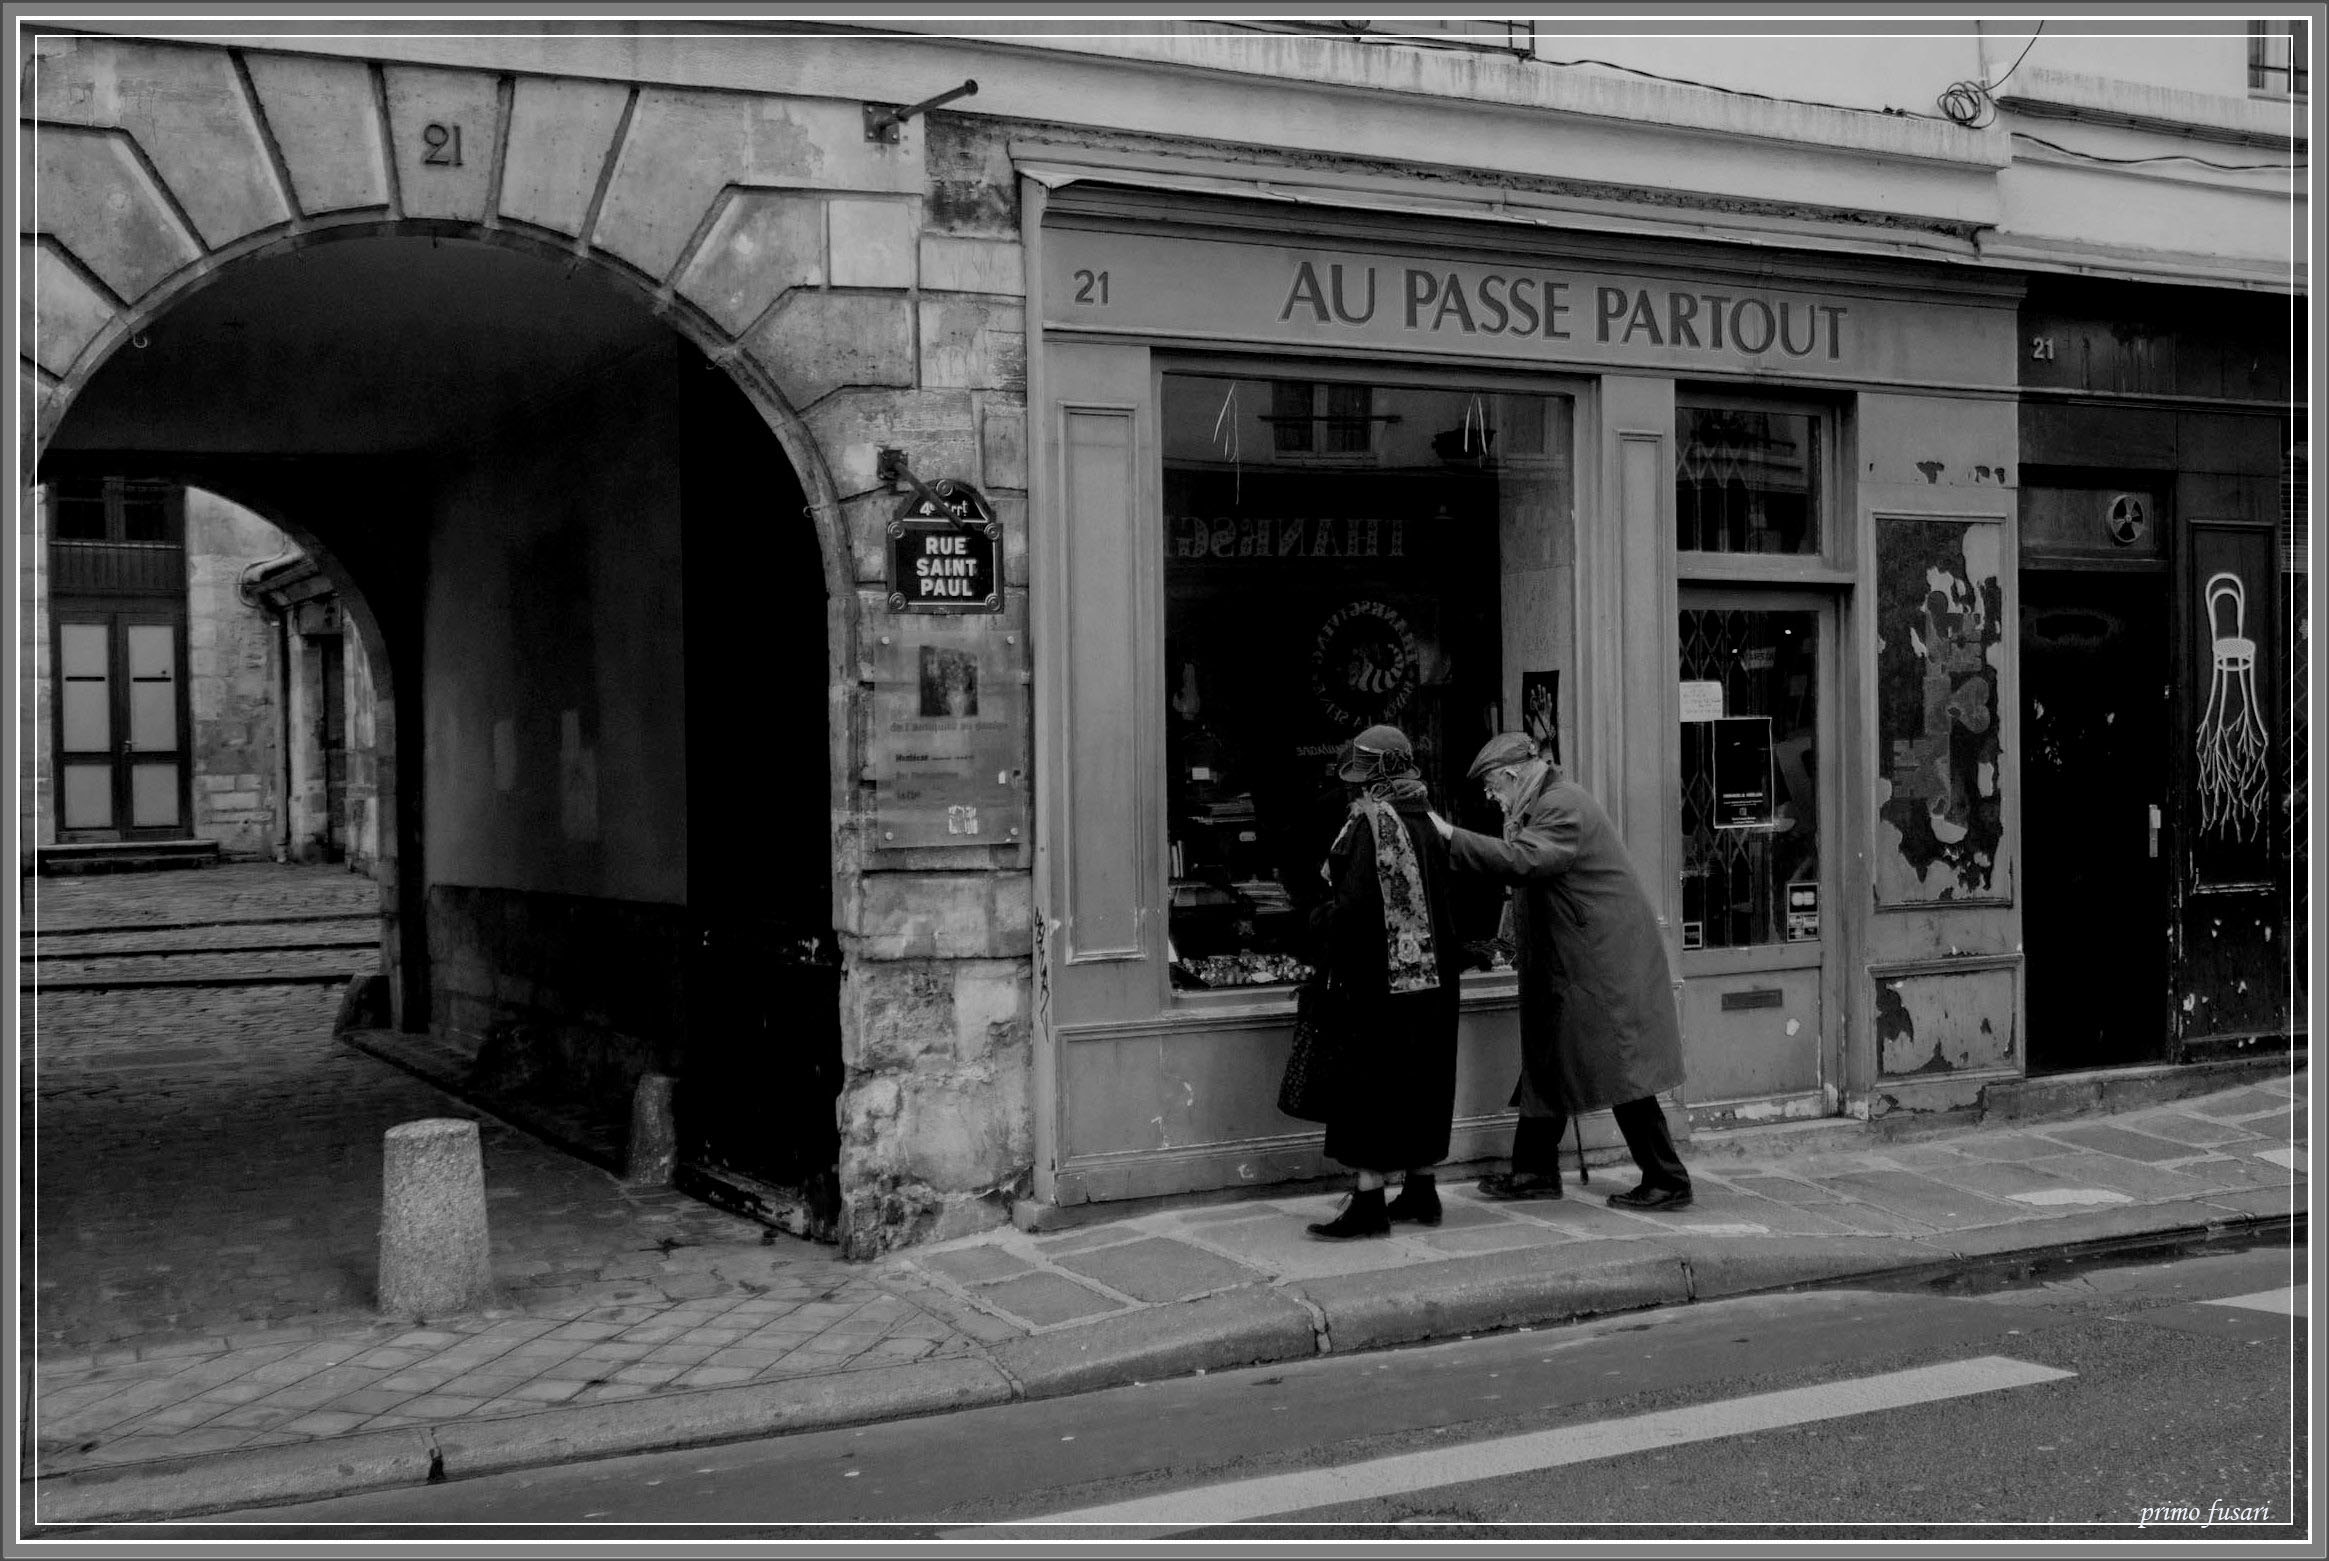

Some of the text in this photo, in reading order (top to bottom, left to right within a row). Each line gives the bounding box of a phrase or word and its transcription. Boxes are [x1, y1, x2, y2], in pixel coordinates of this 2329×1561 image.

[423, 123, 463, 167] 21
[1073, 269, 1109, 305] 21
[1277, 261, 1849, 362] AU PASSE PARTOUT
[2032, 337, 2054, 360] 21
[925, 536, 968, 556] RUE
[916, 558, 978, 577] SAINT
[920, 578, 973, 597] PAUL
